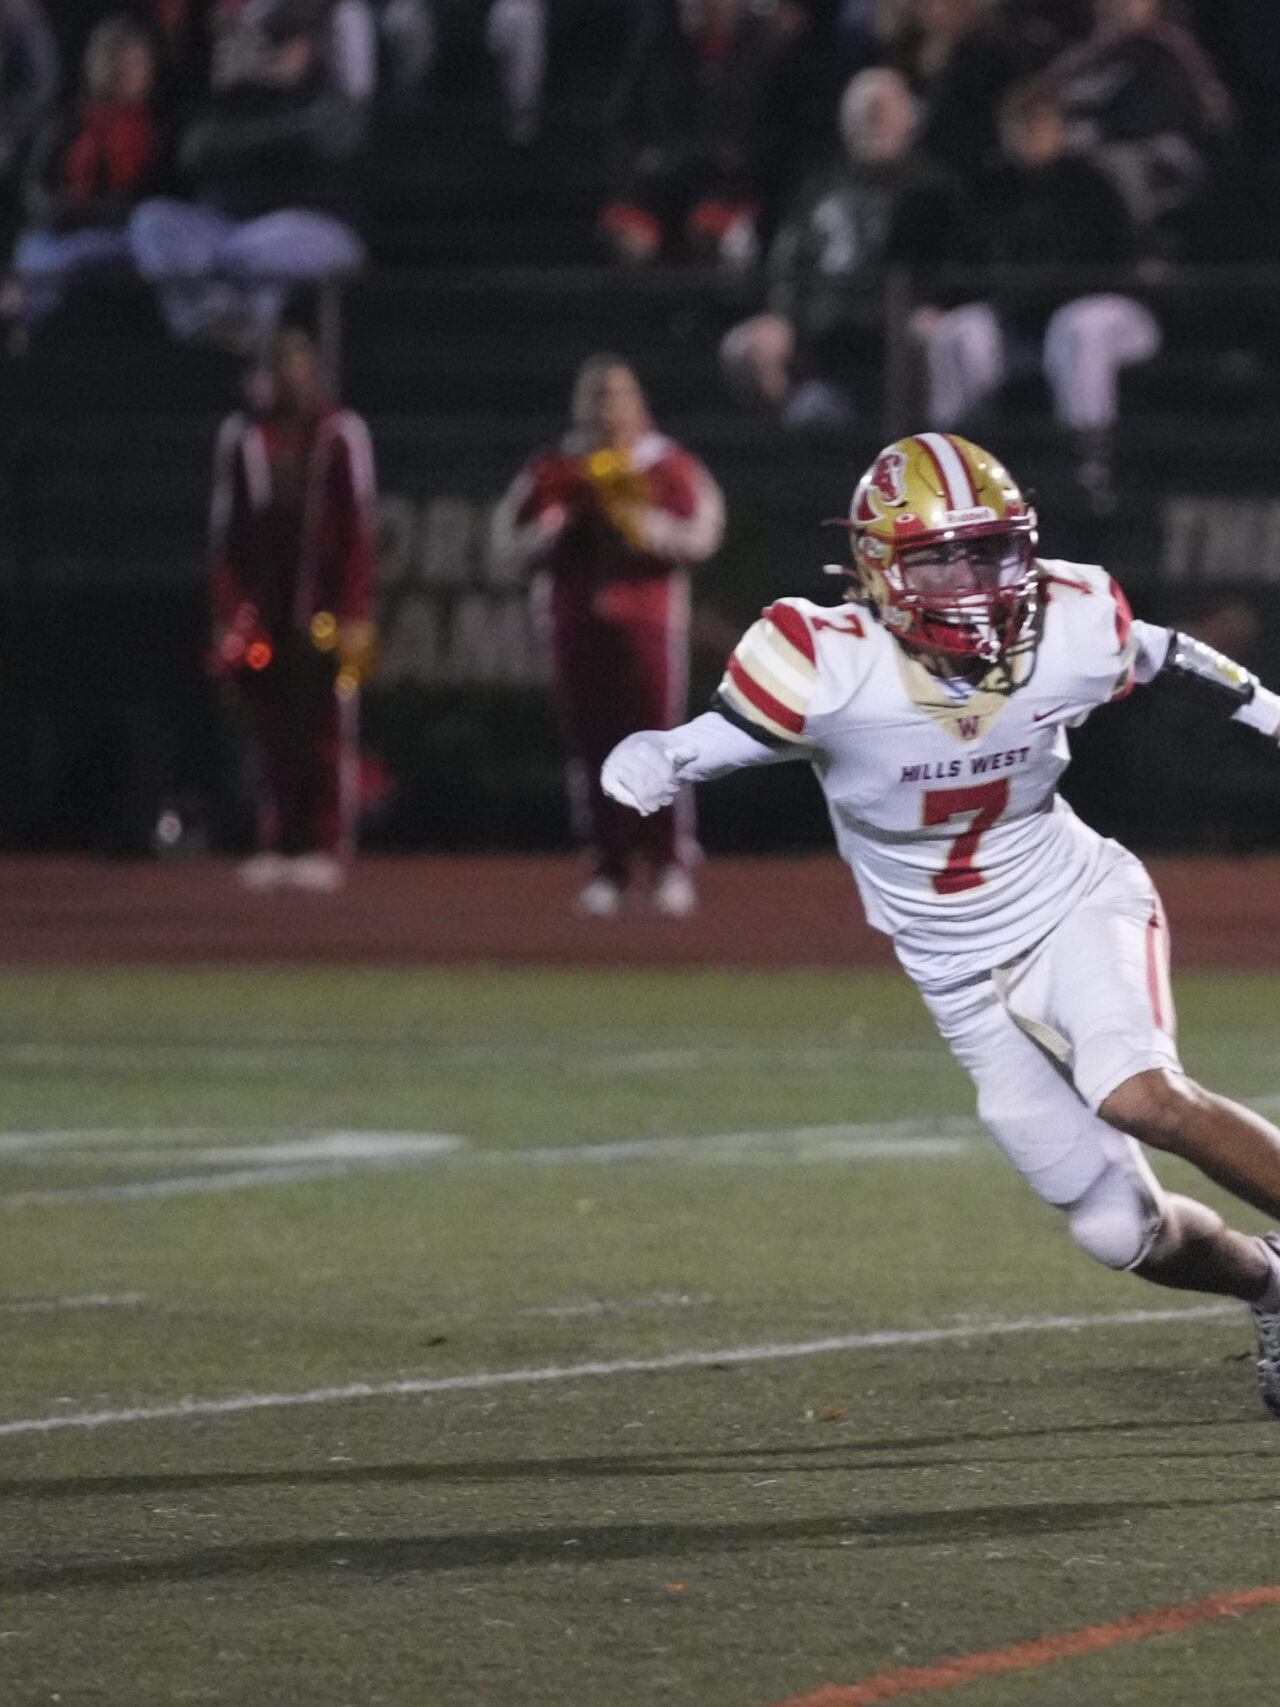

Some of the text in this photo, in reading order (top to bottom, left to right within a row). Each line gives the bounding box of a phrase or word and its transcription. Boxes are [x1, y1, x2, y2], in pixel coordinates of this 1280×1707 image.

[955, 714, 980, 737] W
[900, 746, 1031, 783] HILLS WEST
[921, 776, 1012, 896] 7
